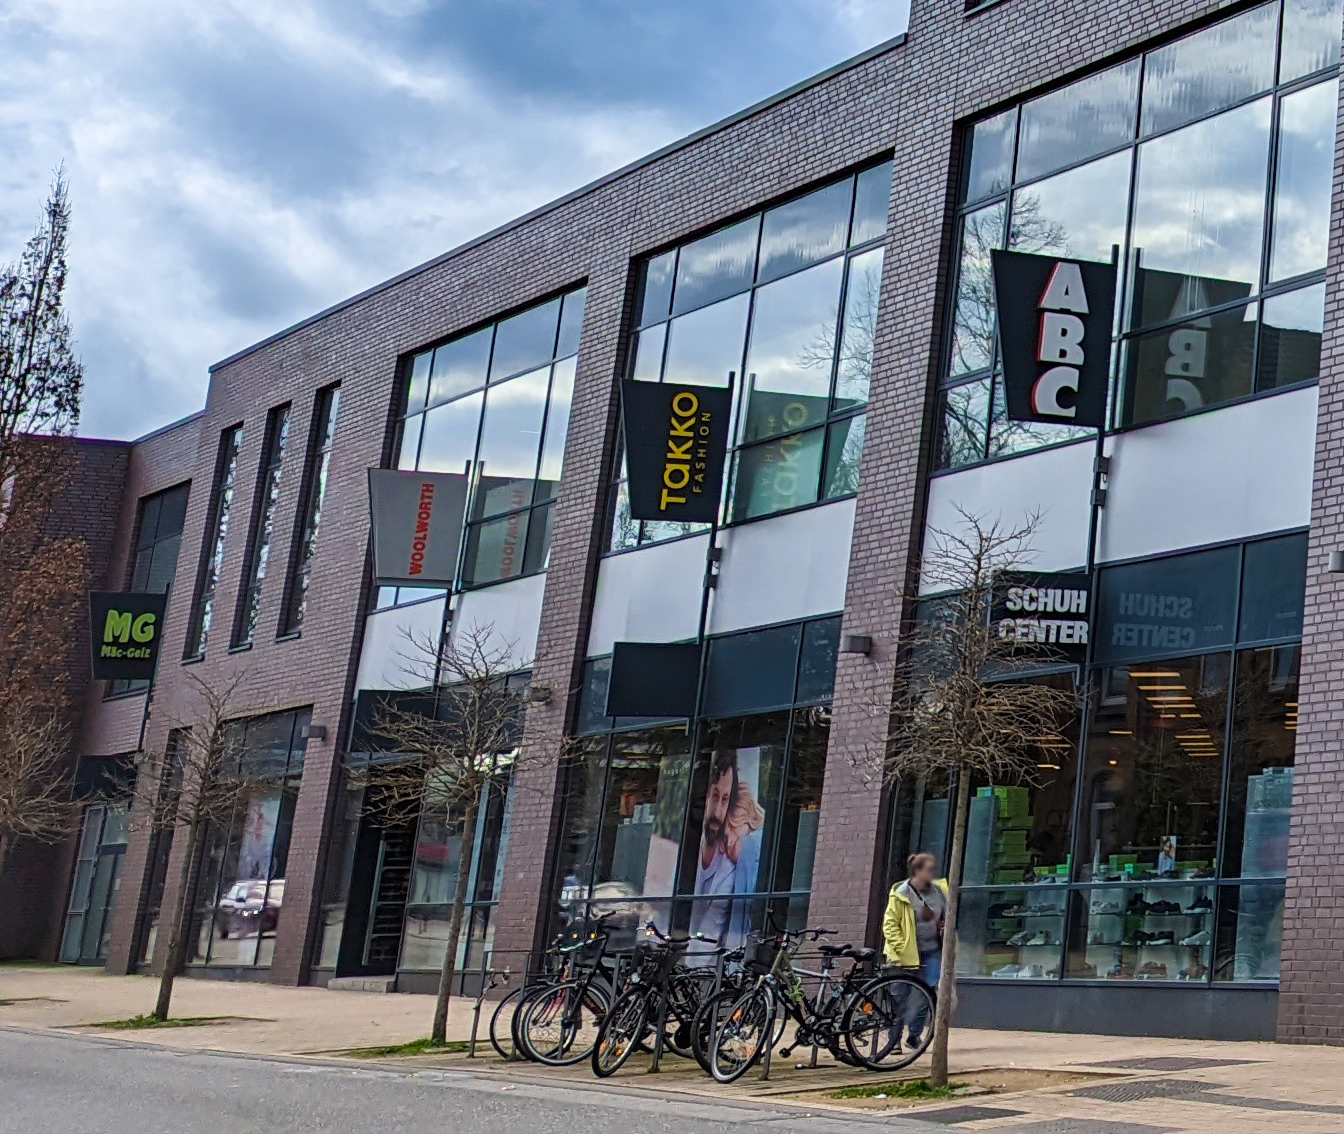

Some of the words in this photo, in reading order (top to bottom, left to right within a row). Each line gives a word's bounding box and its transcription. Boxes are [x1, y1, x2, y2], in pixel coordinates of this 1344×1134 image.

[1031, 261, 1090, 417] ABC
[692, 412, 712, 493] FASHION
[409, 483, 435, 576] WOOLWORTH
[104, 609, 156, 643] MG
[1006, 587, 1088, 613] SCHUH
[999, 618, 1089, 644] CENTER
